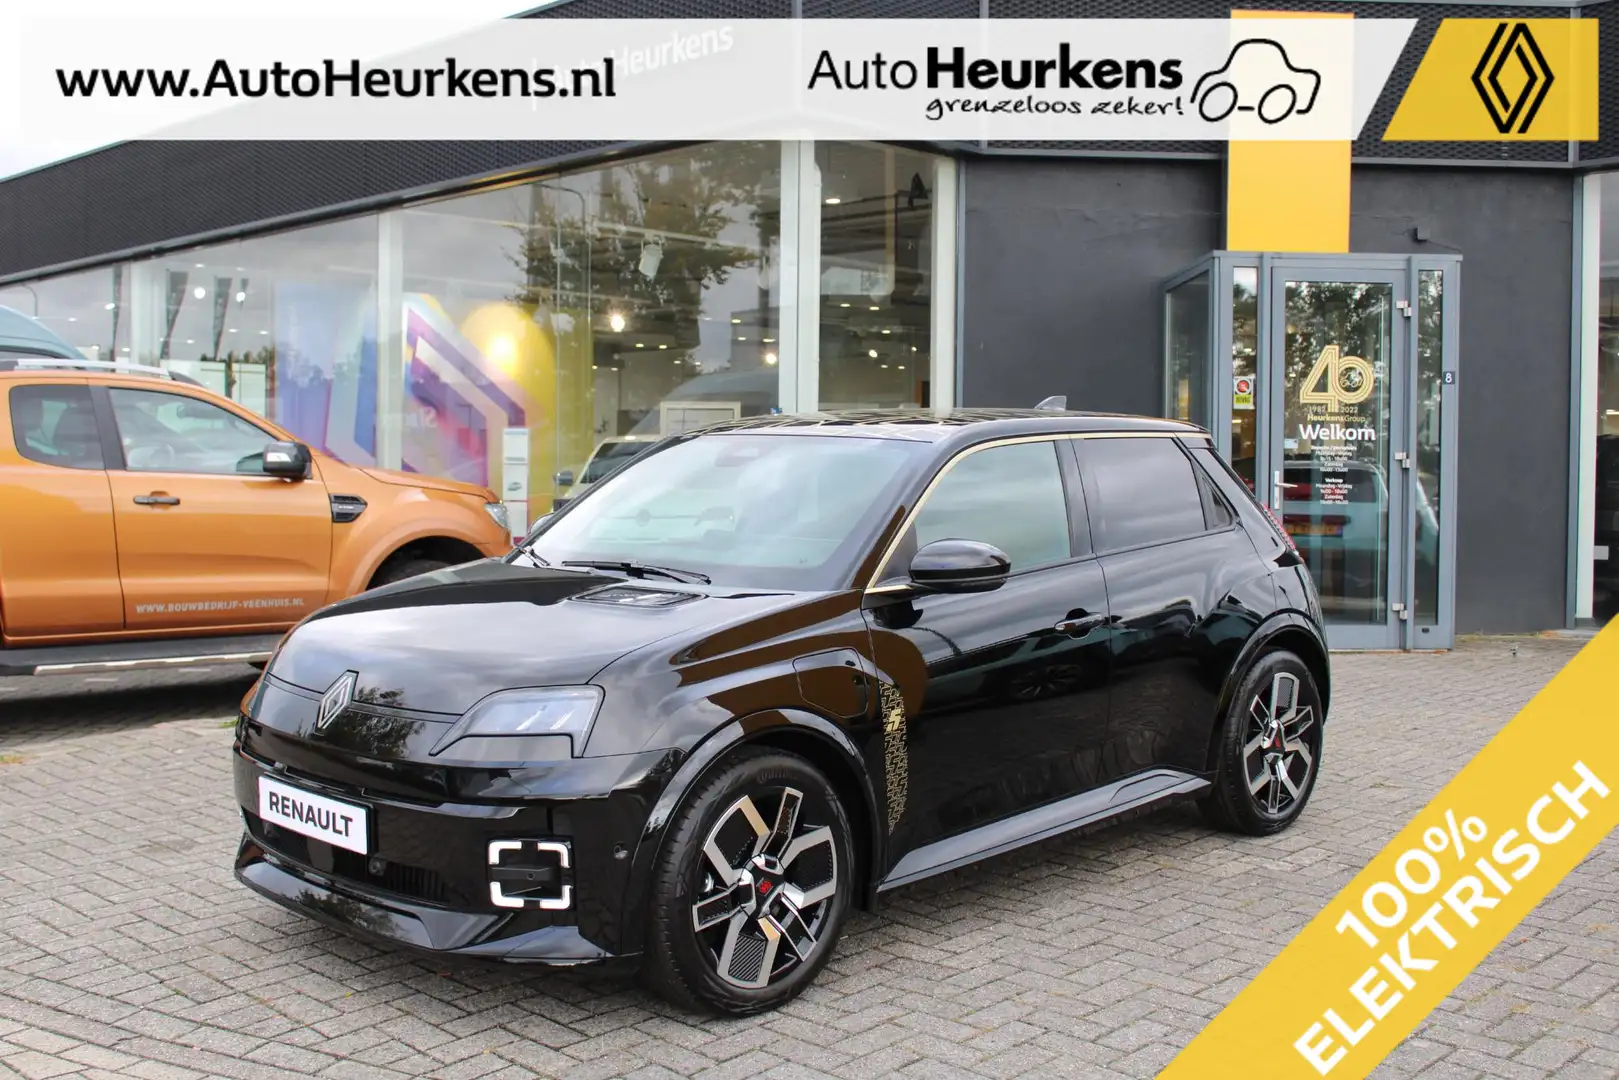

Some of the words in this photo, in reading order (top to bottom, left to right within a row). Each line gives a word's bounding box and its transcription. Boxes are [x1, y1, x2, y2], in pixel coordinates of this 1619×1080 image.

[1445, 372, 1453, 383] 8
[1299, 424, 1376, 440] Welkom
[136, 598, 304, 613] WWW.BOUWBEDRIJF-VEENHUIS.NL
[269, 791, 353, 837] RENAULT
